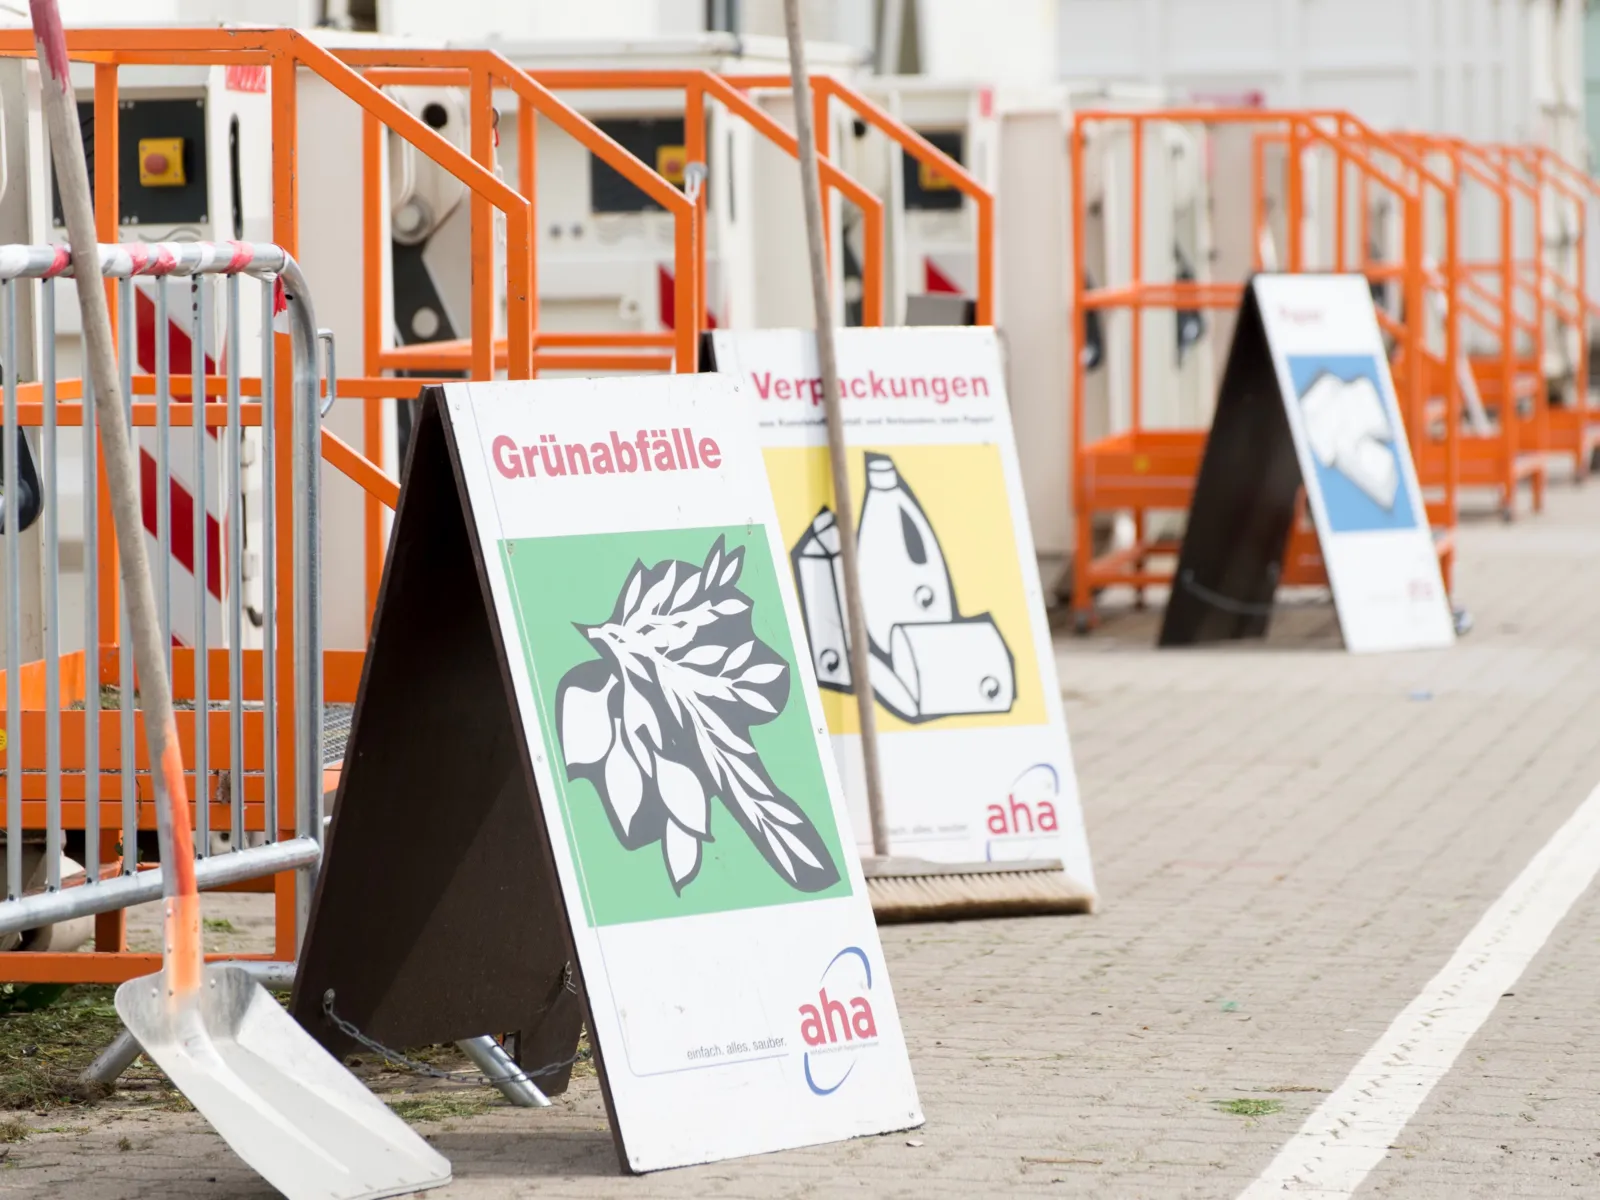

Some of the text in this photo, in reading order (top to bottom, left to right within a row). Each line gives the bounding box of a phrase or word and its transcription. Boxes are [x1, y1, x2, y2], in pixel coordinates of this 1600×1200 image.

[491, 427, 722, 480] Grünabfälle
[986, 793, 1059, 835] aha
[798, 986, 878, 1047] aha
[686, 1044, 724, 1060] einfach.
[752, 1036, 787, 1051] sauber.
